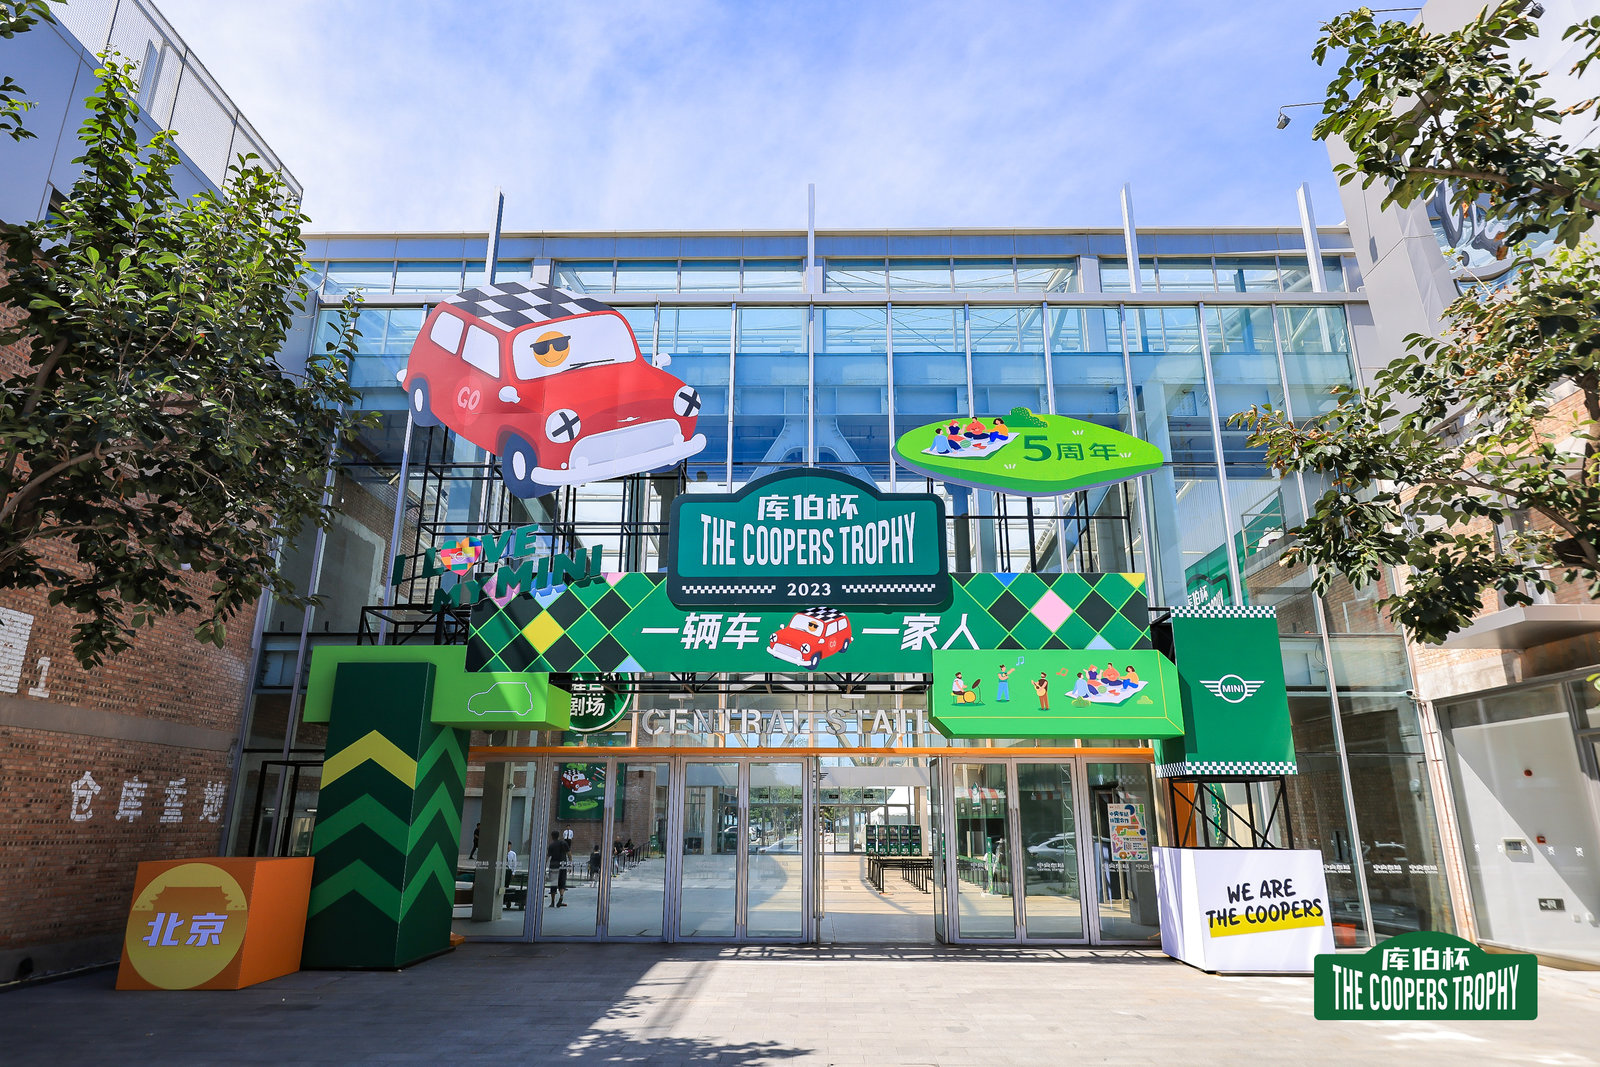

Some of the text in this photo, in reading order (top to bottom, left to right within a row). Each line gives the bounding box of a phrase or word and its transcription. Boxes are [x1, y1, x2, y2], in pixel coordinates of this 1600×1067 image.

[457, 386, 481, 410] GO
[1023, 434, 1119, 462] 5周年
[757, 493, 859, 521] 库伯杯
[421, 523, 540, 579] LVE
[701, 511, 916, 566] THE COOPERS TROPHY
[495, 543, 604, 599] MINI
[787, 582, 832, 597] 2023
[641, 612, 762, 650] 一辆车
[861, 613, 981, 651] 一家人
[1222, 684, 1244, 693] MINI
[641, 708, 940, 736] CENTRAL STATI
[1227, 878, 1296, 904] WE ARE
[1205, 898, 1324, 928] THE COOPERS
[142, 912, 229, 947] 北京
